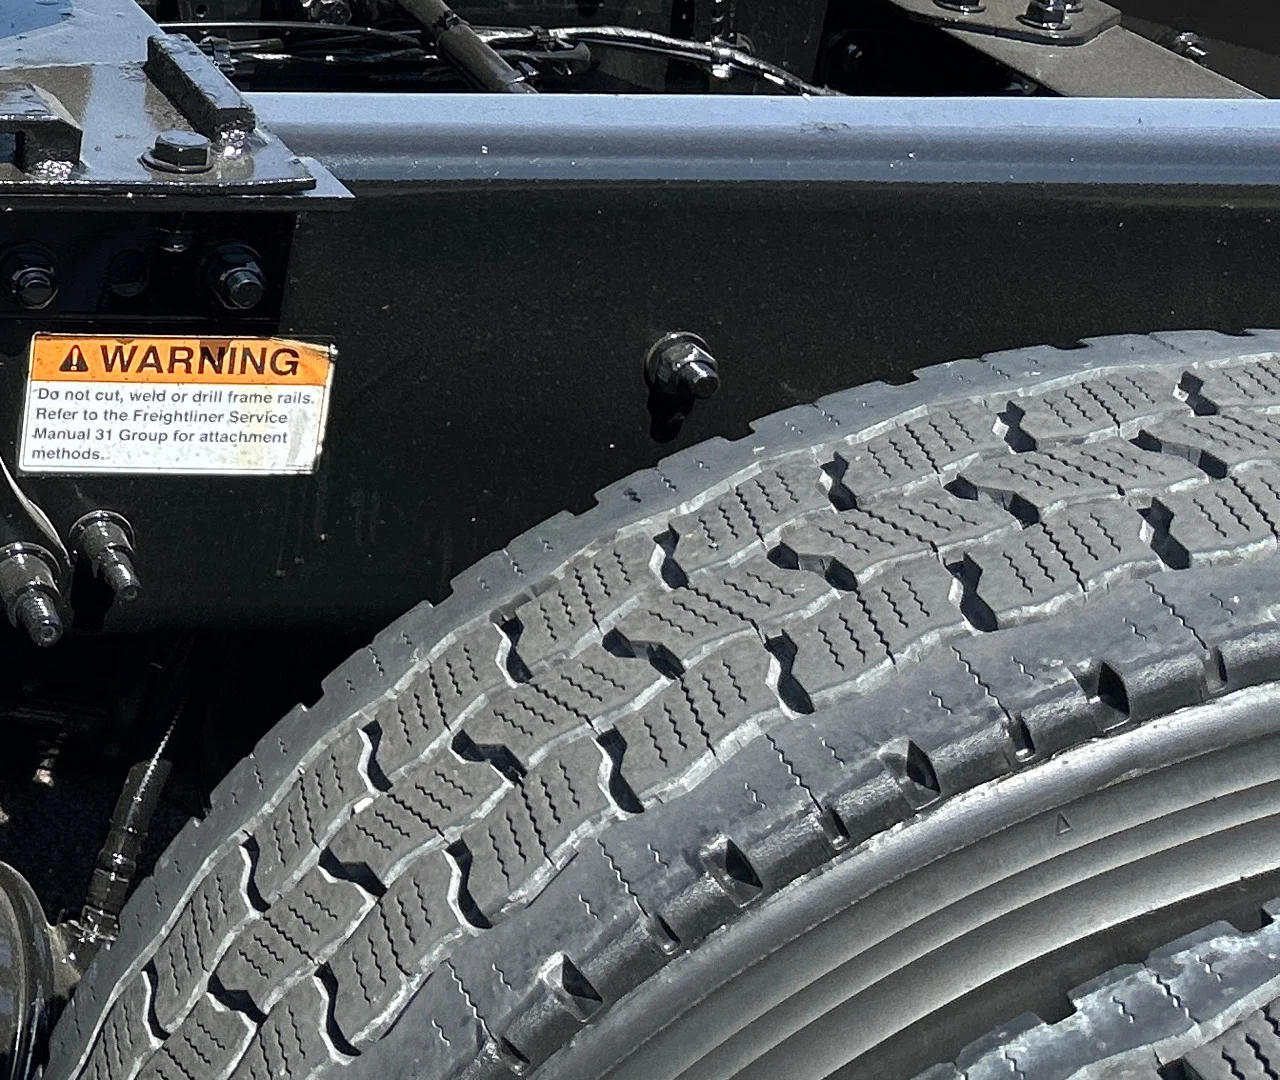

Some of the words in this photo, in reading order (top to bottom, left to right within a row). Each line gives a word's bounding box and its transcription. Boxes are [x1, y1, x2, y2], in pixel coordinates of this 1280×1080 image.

[101, 345, 300, 375] WARNING
[38, 388, 59, 402] Do
[65, 389, 90, 402] not
[96, 389, 124, 403] cut,
[130, 390, 166, 402] weld
[172, 392, 188, 403] or
[192, 390, 222, 403] drill
[228, 392, 272, 403] frame
[278, 392, 314, 405] rails.
[36, 408, 77, 420] Refer
[82, 410, 98, 421] to
[104, 409, 127, 421] the
[134, 410, 224, 424] Freightliner
[229, 411, 288, 423] Service
[33, 429, 90, 440] Manual
[96, 429, 111, 441] 31
[119, 430, 167, 444] Group
[174, 431, 195, 442] for
[200, 431, 287, 443] attachment
[32, 447, 106, 460] methods.
